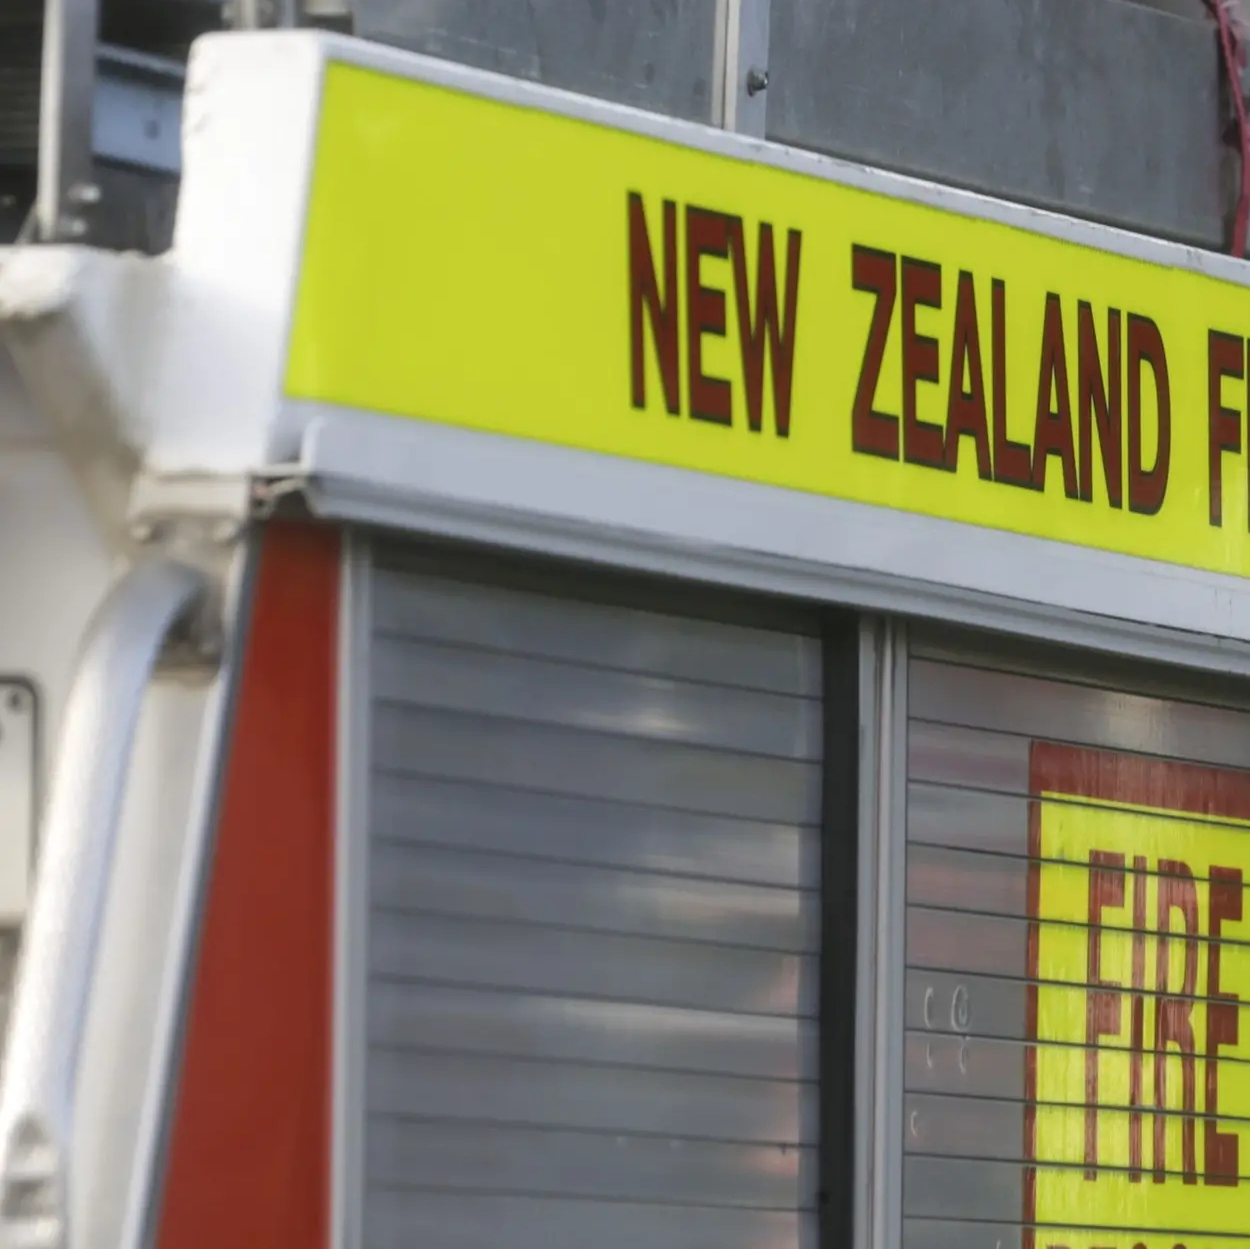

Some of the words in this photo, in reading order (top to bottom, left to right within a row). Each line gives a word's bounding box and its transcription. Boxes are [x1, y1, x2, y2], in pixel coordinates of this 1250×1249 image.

[627, 191, 803, 438] NEW
[850, 242, 1173, 516] ZEALAND
[1083, 849, 1244, 1188] FIRE
